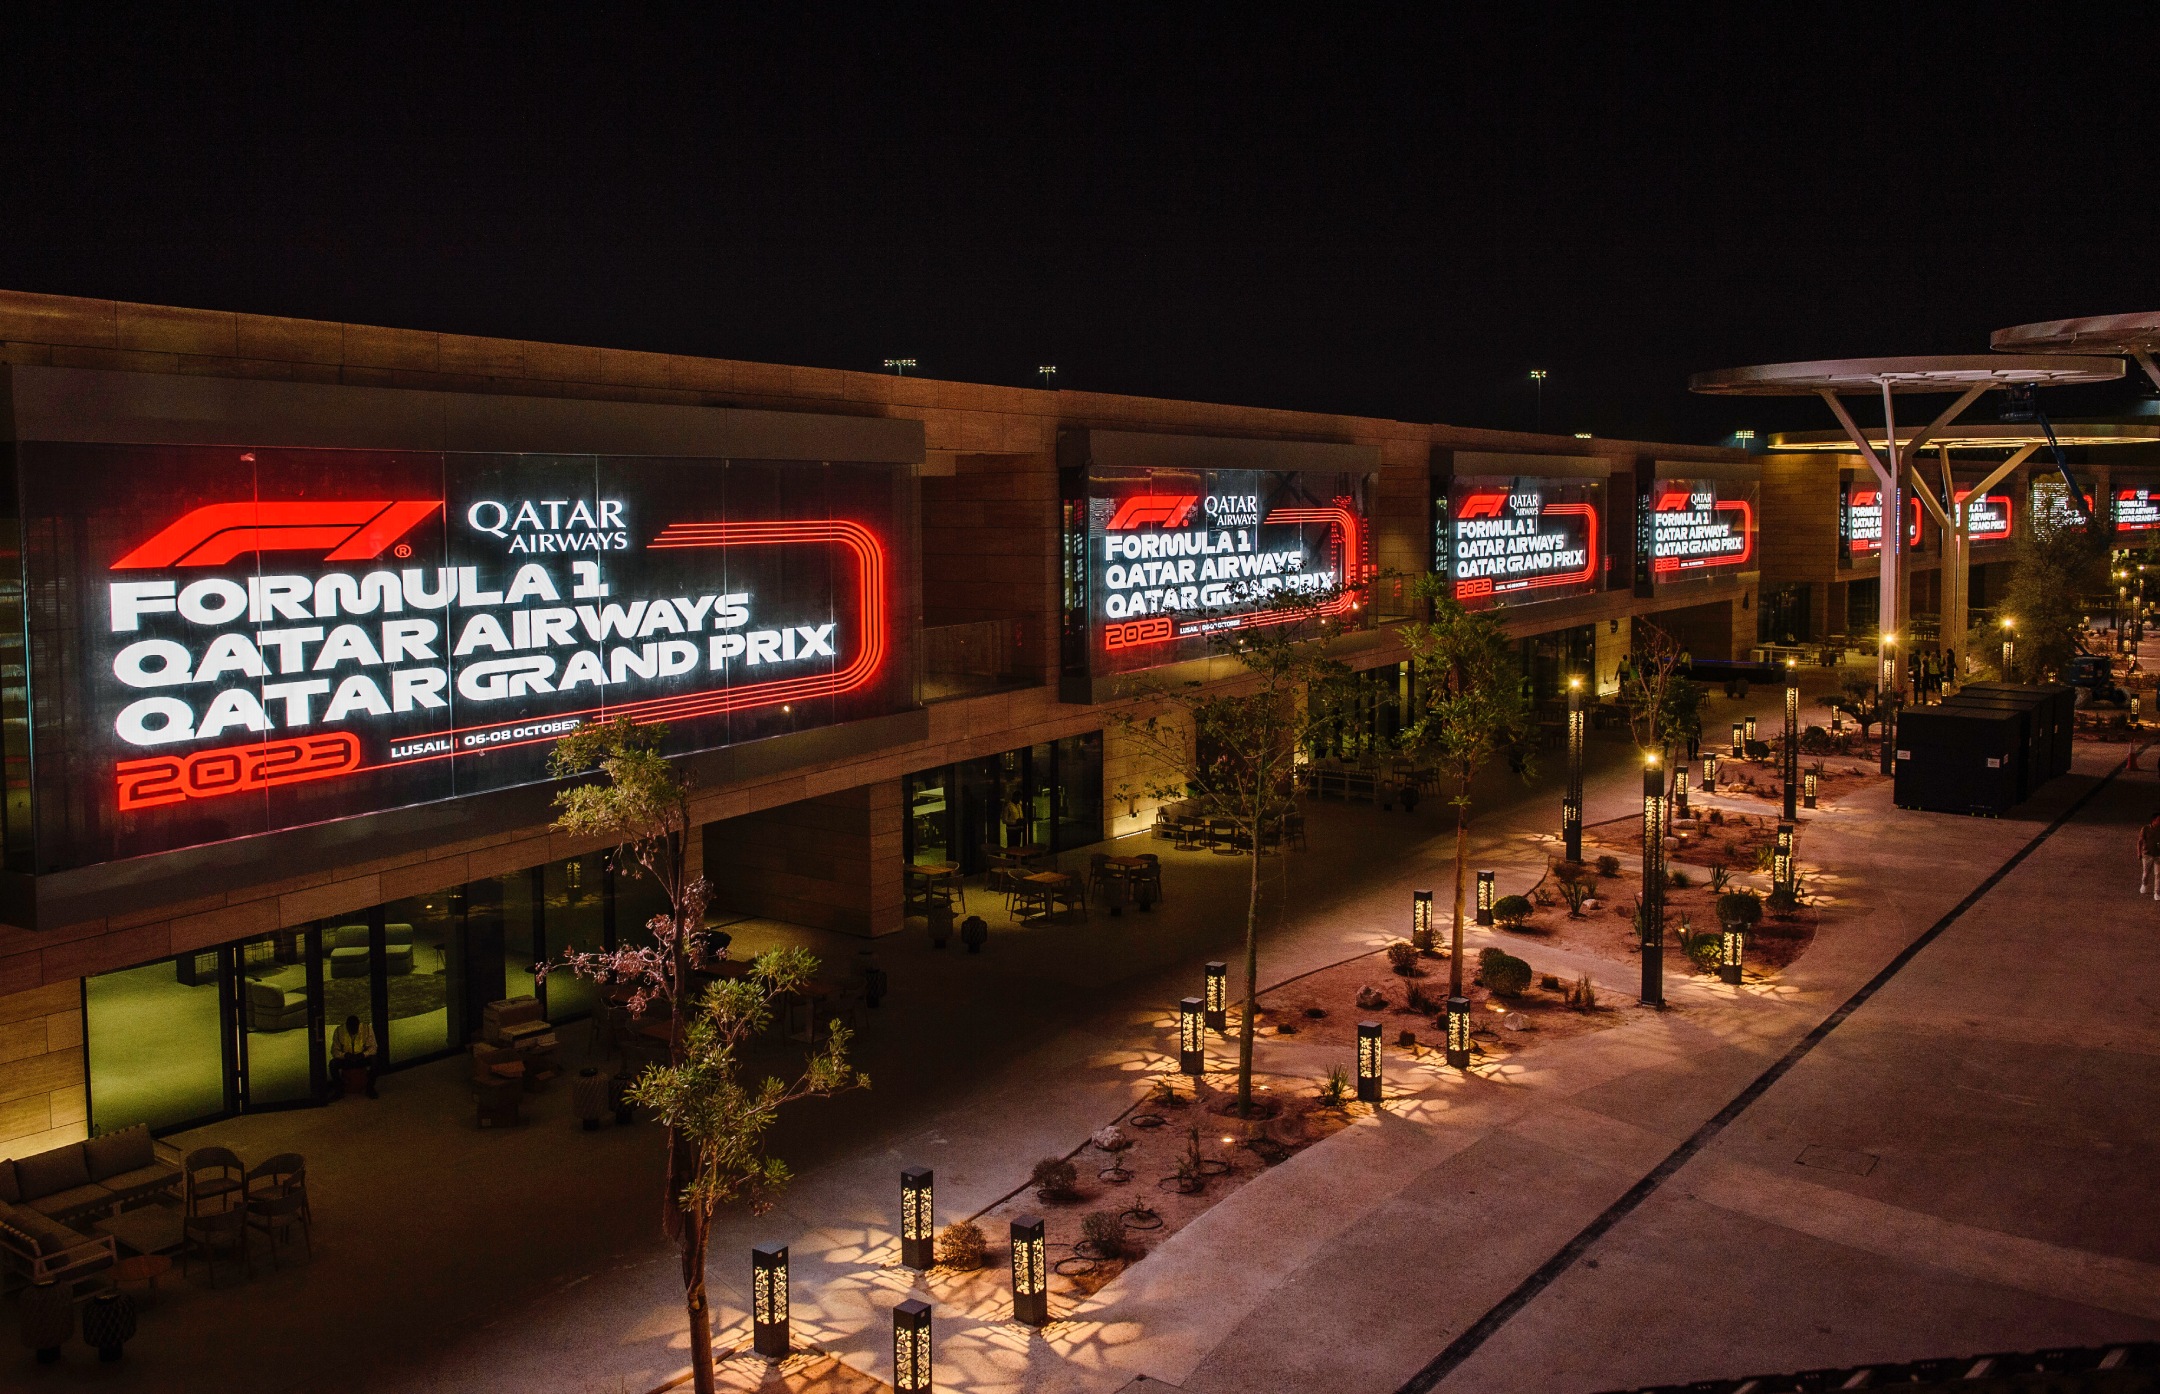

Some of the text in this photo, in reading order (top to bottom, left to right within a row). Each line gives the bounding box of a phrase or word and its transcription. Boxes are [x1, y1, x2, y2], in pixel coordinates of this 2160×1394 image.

[1204, 495, 1257, 514] QATAR
[1509, 494, 1538, 510] QATAR
[1690, 494, 1712, 505] QATAR
[468, 500, 627, 538] QATAR
[1217, 514, 1257, 527] AIRWAYS
[1458, 518, 1535, 539] FORMULA 1
[1655, 512, 1710, 527] FORMULA 1
[1852, 517, 1874, 528] QATAR
[508, 532, 628, 553] AIRWAYS
[1655, 524, 1729, 541] QATAR AIRWAYS
[1852, 528, 1874, 539] QATAR
[1106, 530, 1250, 560] FORMULA 1
[1457, 534, 1564, 559] QATAR AIRWAYS
[1655, 536, 1742, 556] QATAR GRAND PRIX
[1105, 551, 1302, 590] QATAR AIRWAYS
[1457, 549, 1584, 578] QATAR GRAND PRIX
[1655, 557, 1680, 572] 2023
[110, 561, 609, 632] FORMULA 1
[1105, 571, 1336, 619] QATAR GRAND PRIX
[1456, 578, 1492, 599] 2023
[113, 593, 749, 688] QATAR AIRWAYS
[1105, 617, 1172, 650] 2023
[115, 624, 837, 746] QATAR GRAND PRIX
[391, 739, 450, 758] LUSAIL
[464, 730, 511, 746] 06-08
[116, 731, 361, 811] 2023
